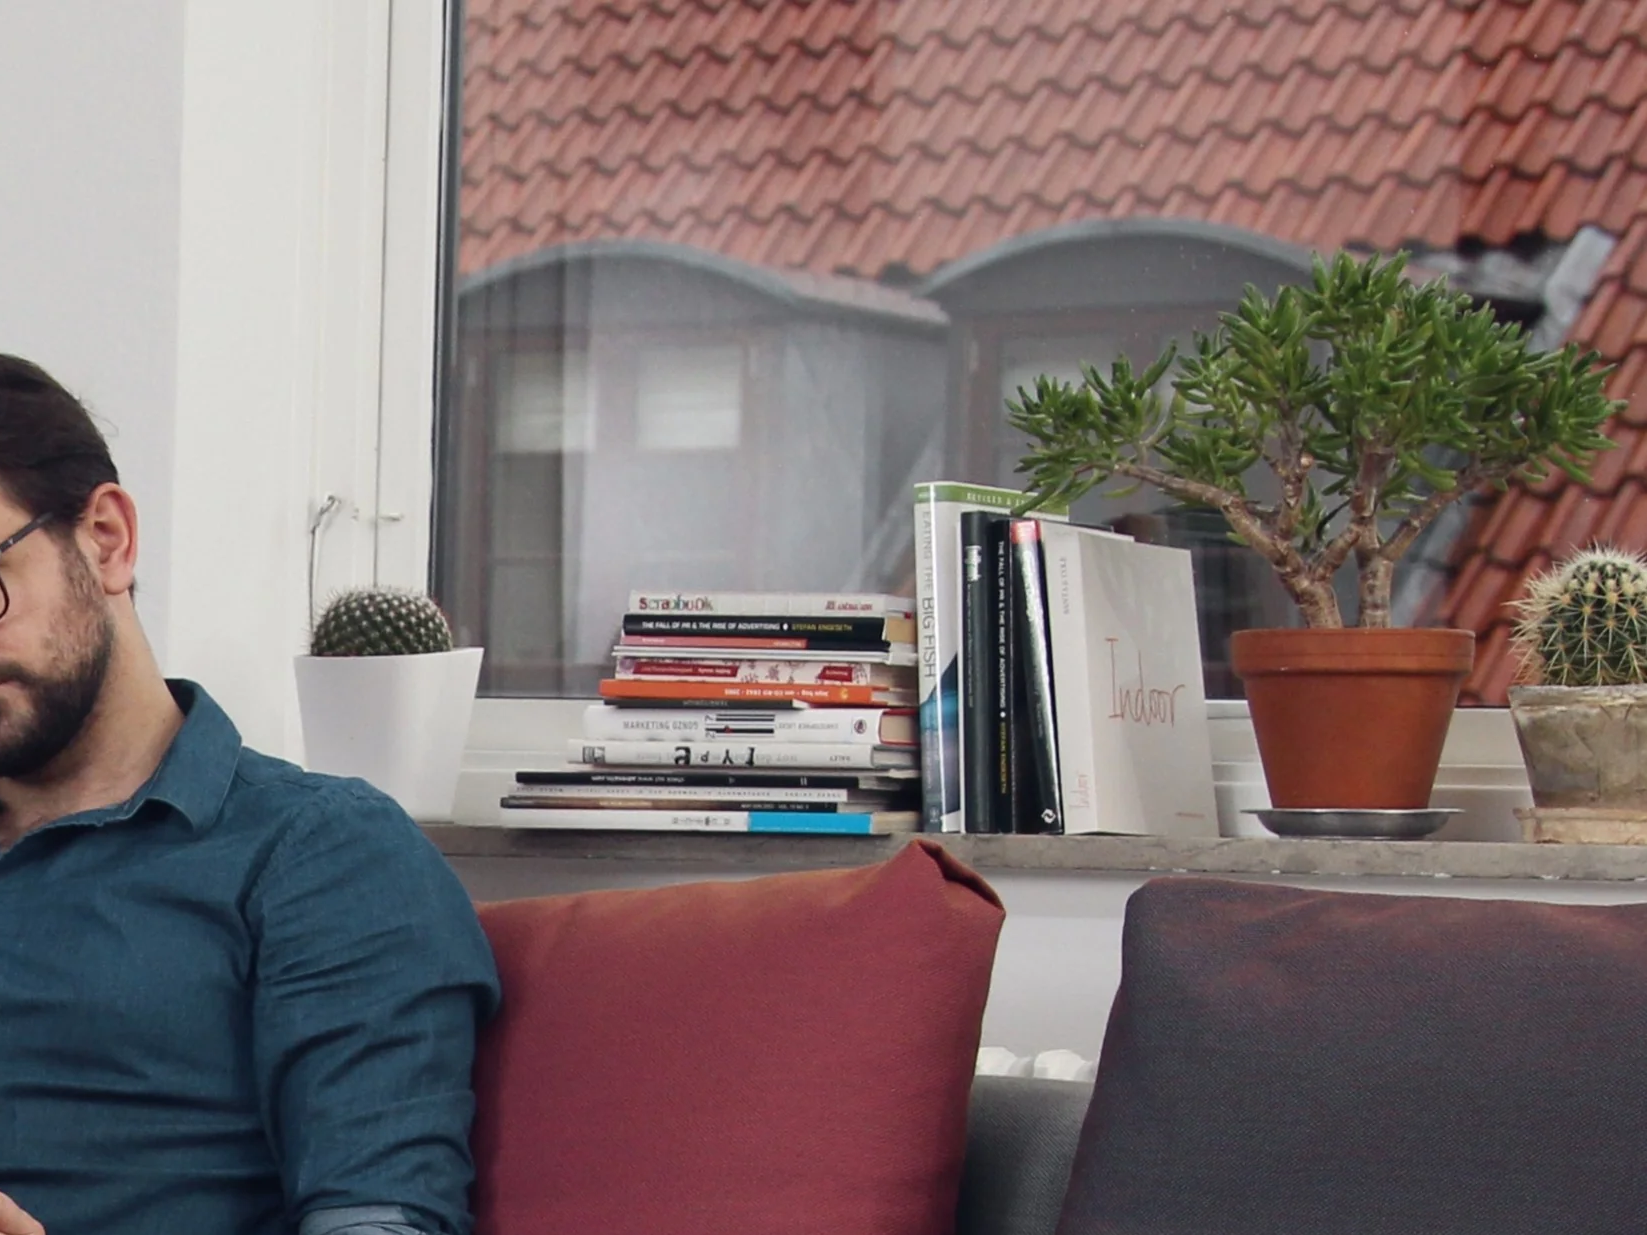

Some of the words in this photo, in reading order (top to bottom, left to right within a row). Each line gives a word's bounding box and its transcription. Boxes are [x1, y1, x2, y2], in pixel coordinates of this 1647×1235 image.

[922, 510, 932, 560] EATING
[923, 566, 933, 591] THE
[642, 621, 654, 629] THE
[655, 621, 671, 629] FALL
[698, 622, 711, 630] THE
[737, 622, 781, 631] ADVERTISING
[922, 596, 935, 629] BIG
[923, 633, 936, 678] FISH
[1104, 637, 1186, 728] Indoor
